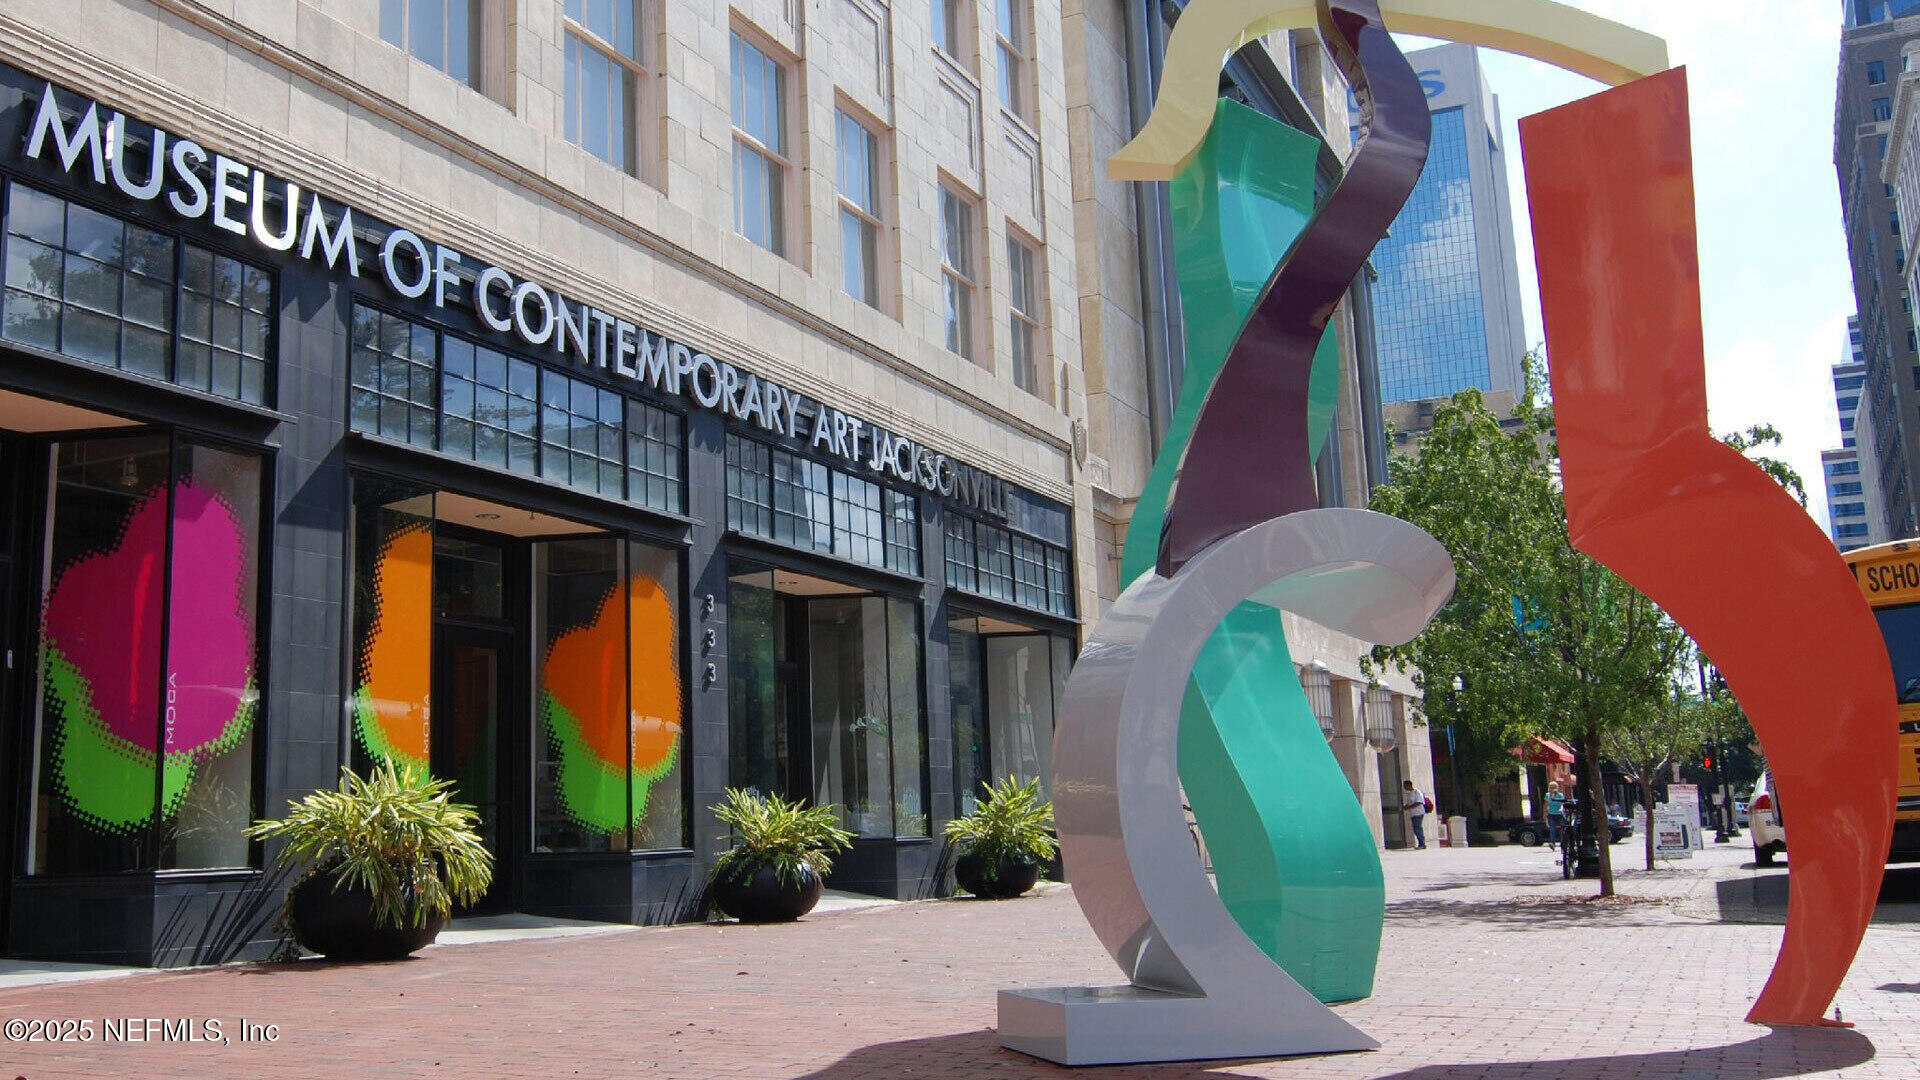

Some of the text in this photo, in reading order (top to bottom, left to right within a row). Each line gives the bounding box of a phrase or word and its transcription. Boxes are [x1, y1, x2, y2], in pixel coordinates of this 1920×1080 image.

[26, 82, 1014, 520] MUSEUM OF CONTEMPORARY ART JACKSONVILLE
[1867, 561, 1920, 593] SCHO
[166, 672, 177, 744] MOCA
